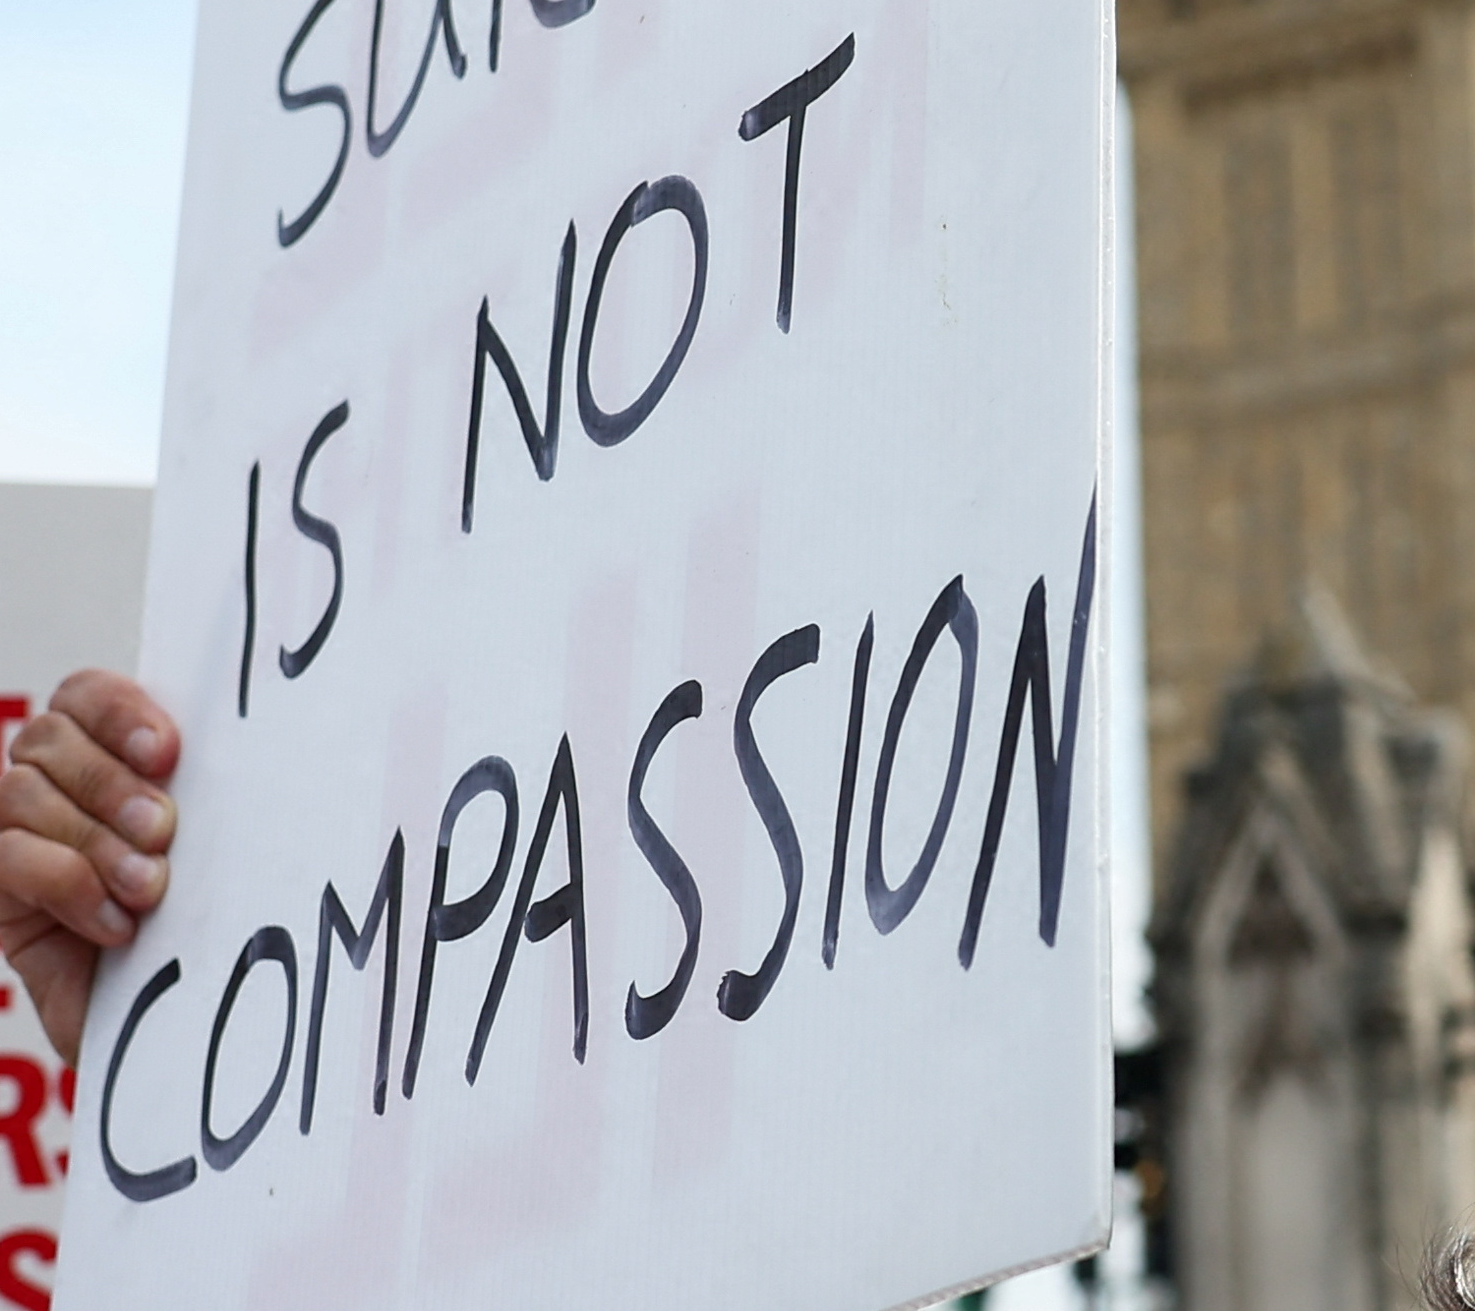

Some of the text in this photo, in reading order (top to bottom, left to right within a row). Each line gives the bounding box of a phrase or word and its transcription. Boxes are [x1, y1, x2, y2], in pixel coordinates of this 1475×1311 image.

[238, 31, 856, 719] IS NOT
[99, 485, 1097, 1203] COMPASSION
